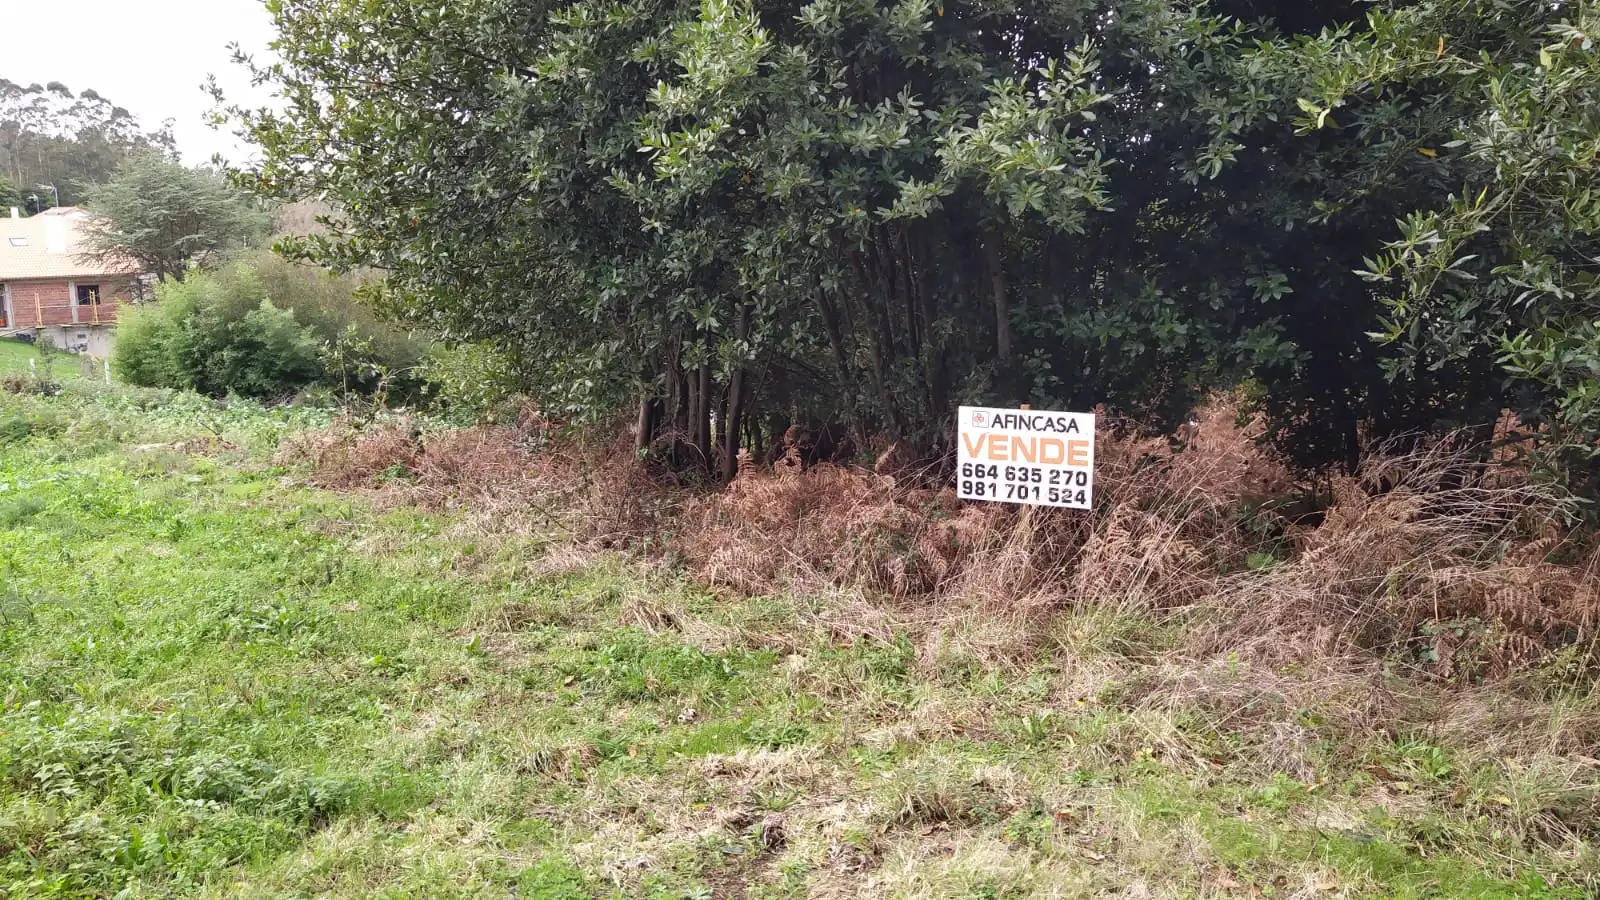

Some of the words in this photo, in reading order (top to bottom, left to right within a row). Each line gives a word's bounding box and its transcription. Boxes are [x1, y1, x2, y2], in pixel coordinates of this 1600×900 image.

[991, 413, 1080, 433] AFINCASA
[962, 432, 1090, 467] VENDE
[962, 462, 999, 480] 664
[1004, 465, 1042, 484] 635
[1049, 468, 1088, 487] 270
[962, 480, 997, 498] 981
[1005, 483, 1040, 501] 701
[1048, 487, 1086, 505] 524
